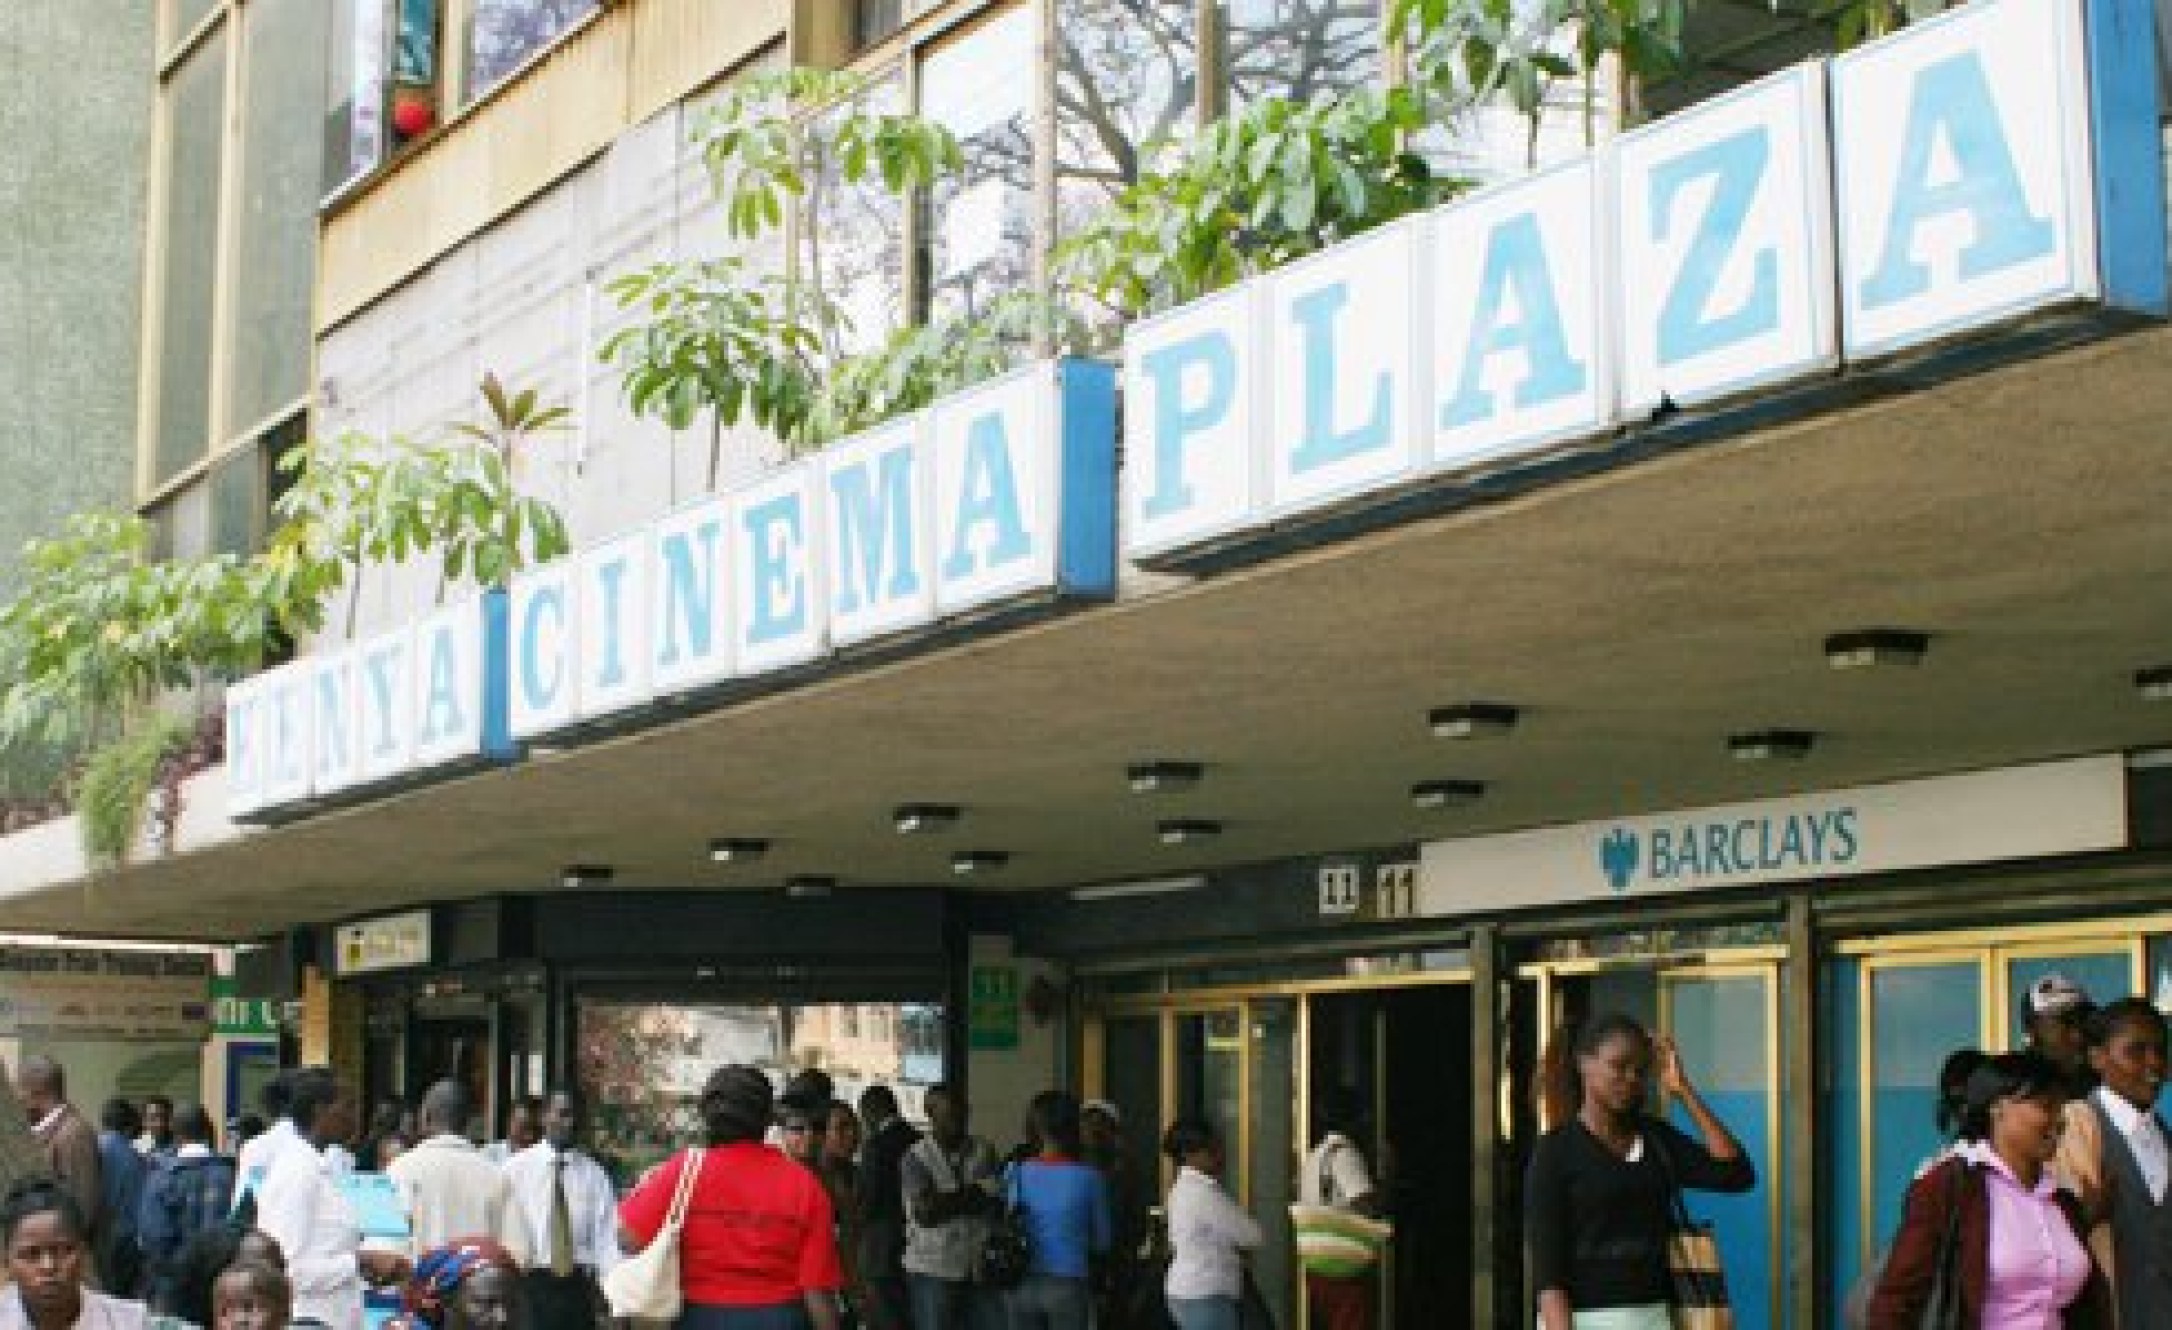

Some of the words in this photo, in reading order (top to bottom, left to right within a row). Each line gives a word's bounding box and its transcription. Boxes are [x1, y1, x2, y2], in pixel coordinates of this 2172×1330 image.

[518, 410, 1032, 710] CINEMA
[1141, 50, 2055, 519] PLAZA
[1648, 806, 1857, 878] BARCLAYS
